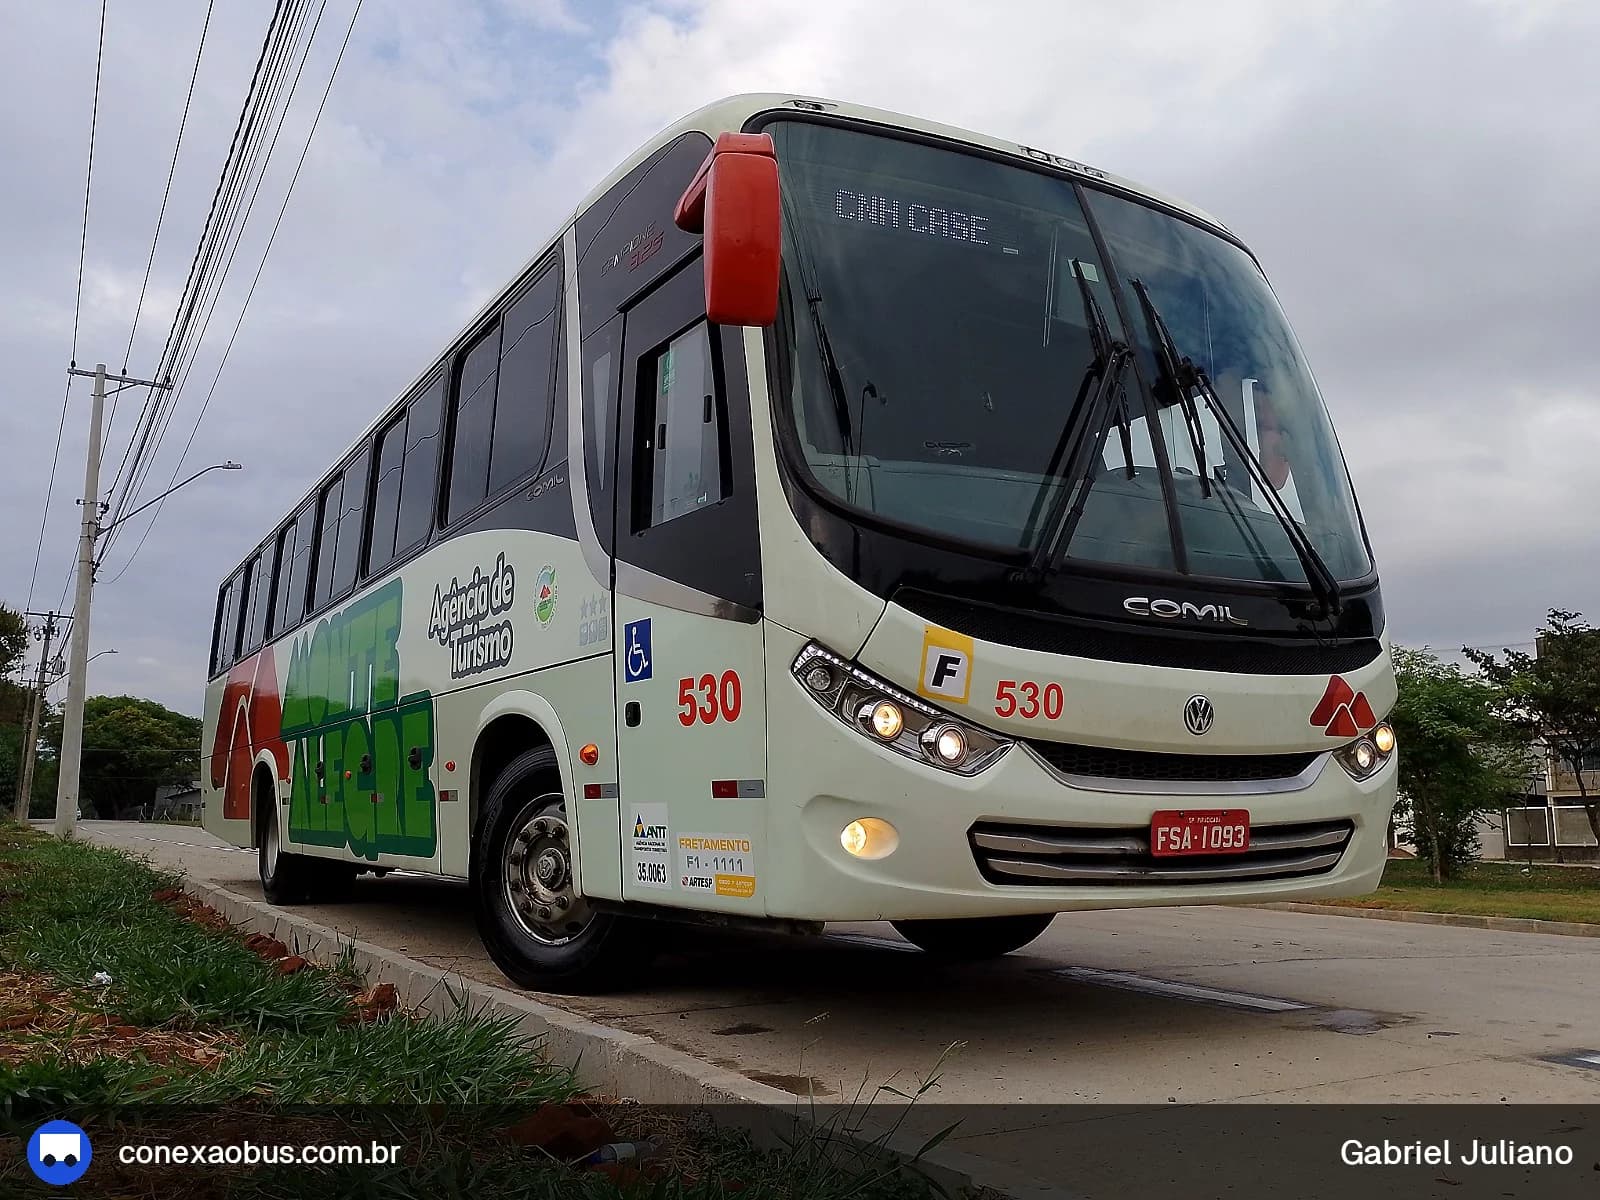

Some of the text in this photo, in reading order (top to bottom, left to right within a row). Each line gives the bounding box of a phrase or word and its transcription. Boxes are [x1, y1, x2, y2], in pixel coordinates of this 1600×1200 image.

[836, 189, 989, 245] CNH CASE
[526, 474, 565, 501] COMIL
[429, 565, 489, 642] Agência
[490, 552, 515, 616] de
[1123, 597, 1248, 626] COMIL
[450, 621, 513, 679] Turismo
[931, 653, 962, 689] F
[678, 668, 742, 727] 530
[994, 679, 1064, 720] 530
[289, 692, 436, 858] ALEGRE
[645, 825, 667, 839] ANTT
[679, 837, 750, 853] FRETAMENTO
[637, 862, 667, 883] 35.0063
[686, 855, 700, 870] F1
[713, 856, 743, 873] 1111
[688, 876, 713, 889] ARTESP
